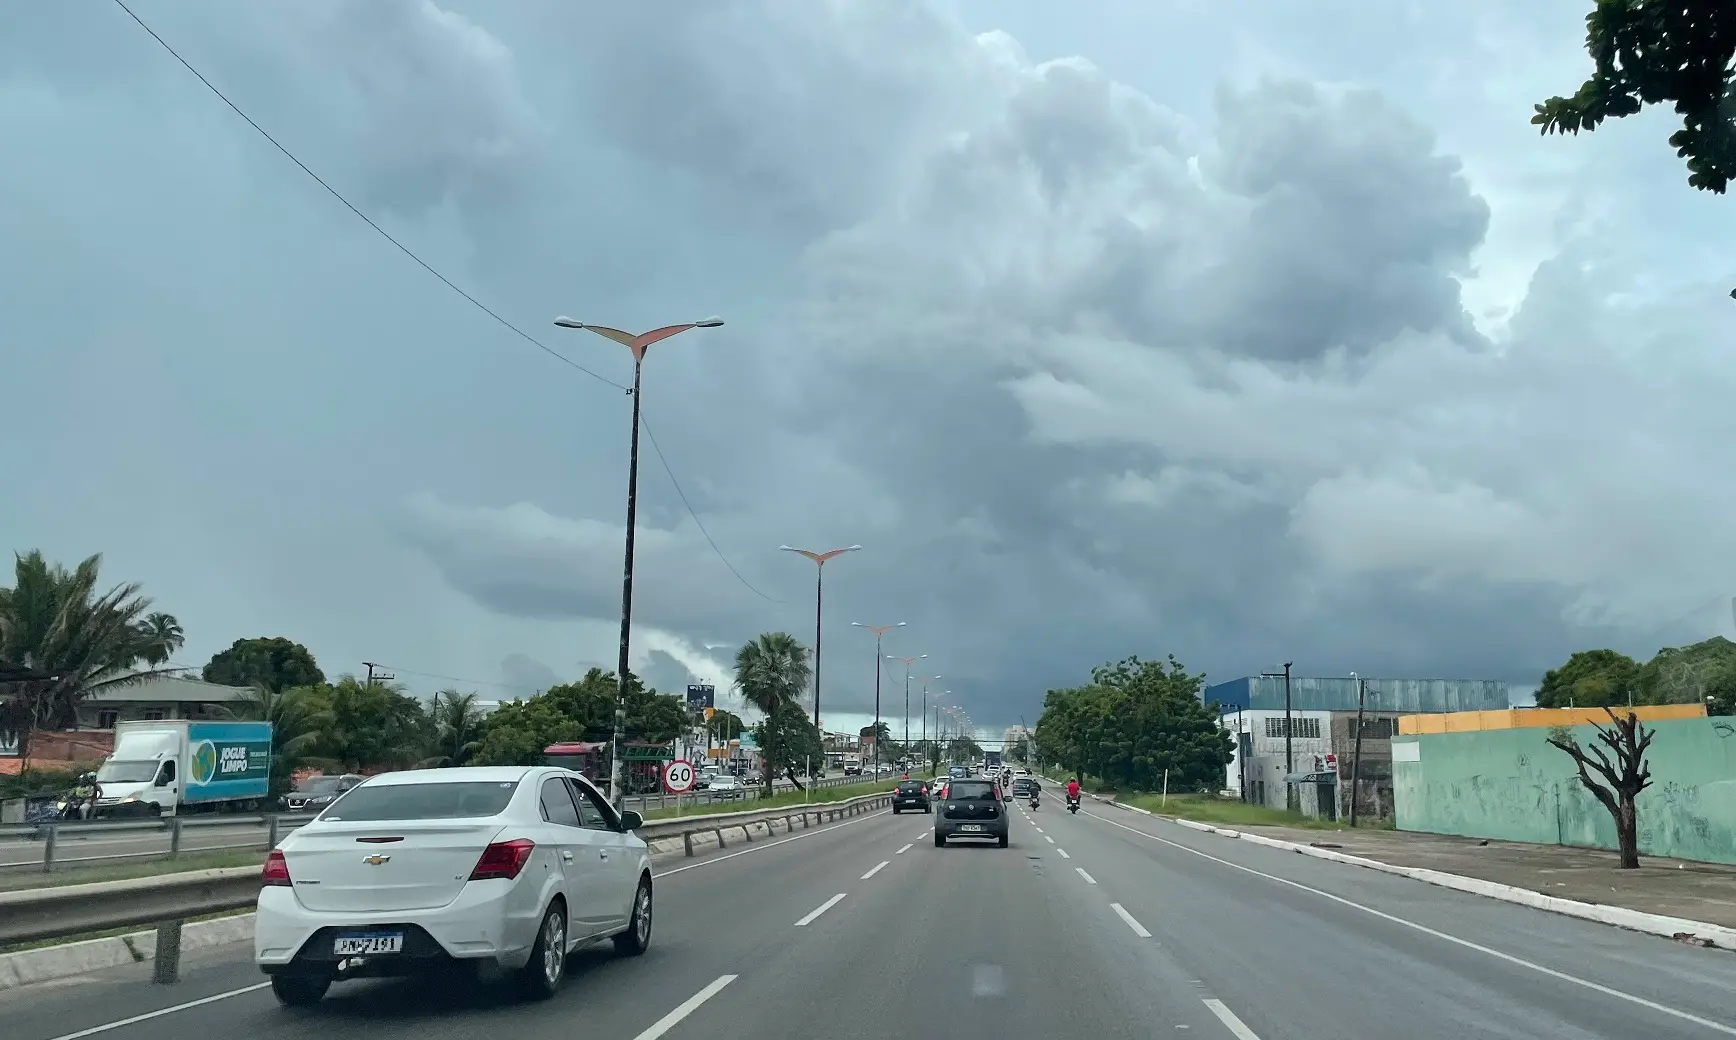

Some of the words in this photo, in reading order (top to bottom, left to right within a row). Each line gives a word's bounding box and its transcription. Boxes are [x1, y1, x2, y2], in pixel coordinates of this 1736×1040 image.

[221, 747, 247, 761] JOGUE
[220, 759, 248, 773] LIMPO
[670, 768, 690, 782] 60
